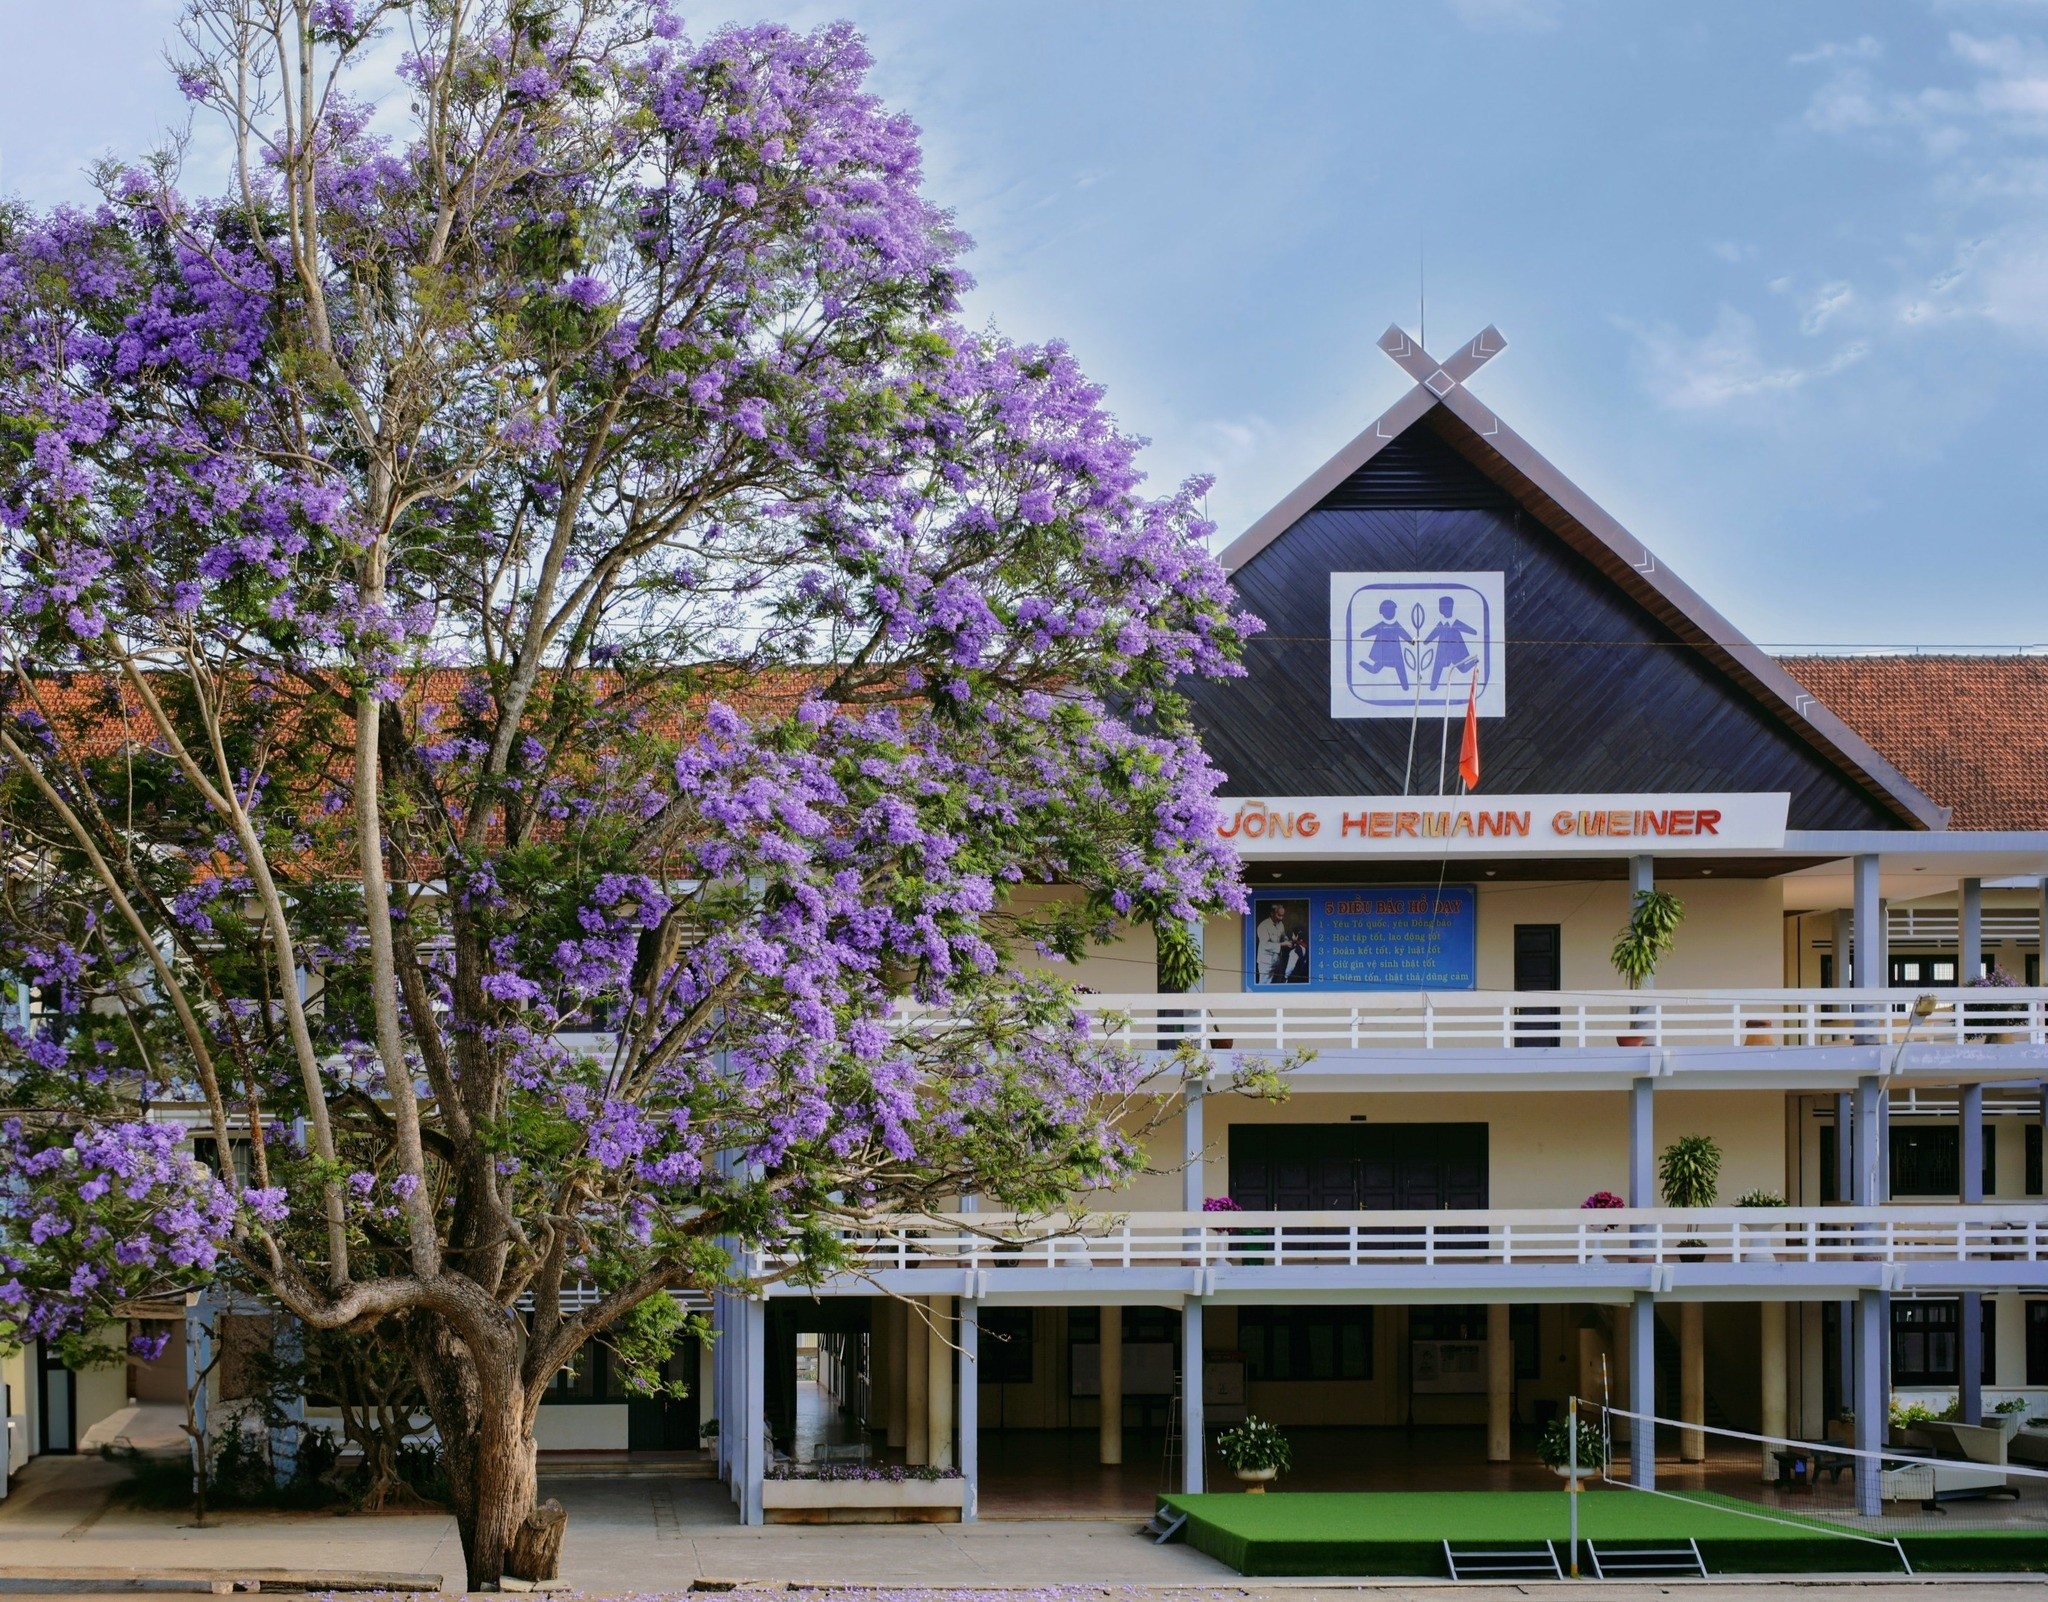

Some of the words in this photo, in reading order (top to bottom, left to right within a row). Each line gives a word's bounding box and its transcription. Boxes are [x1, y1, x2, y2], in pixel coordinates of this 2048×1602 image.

[1342, 808, 1531, 838] HERMANN
[1552, 808, 1722, 837] GMEINER
[1325, 901, 1334, 915] 5
[1338, 894, 1373, 915] ĐIỀU
[1376, 897, 1405, 914] BÁC
[1408, 894, 1428, 914] HỒ
[1433, 900, 1462, 917] DẠY
[1332, 919, 1350, 928] Yêu
[1392, 919, 1409, 930] yêu
[1318, 934, 1324, 942] 2
[1332, 933, 1350, 943] Học
[1352, 933, 1367, 943] tập
[1370, 931, 1386, 942] tốt,
[1389, 933, 1401, 941] lao
[1404, 932, 1425, 943] động
[1428, 931, 1441, 941] tốt
[1318, 947, 1324, 955] 3
[1358, 945, 1373, 955] kết
[1375, 945, 1391, 955] tốt,
[1408, 945, 1425, 955] luật
[1428, 945, 1441, 954] tốt
[1318, 961, 1324, 969] 4
[1332, 960, 1349, 969] Giữ
[1367, 959, 1377, 969] vệ
[1380, 959, 1398, 968] sinh
[1401, 959, 1420, 969] thật
[1423, 958, 1436, 967] tốt
[1318, 974, 1324, 982] 5
[1332, 974, 1361, 982] Khiêm
[1365, 972, 1382, 982] tốn,
[1385, 973, 1403, 981] thật
[1450, 971, 1469, 980] cảm
